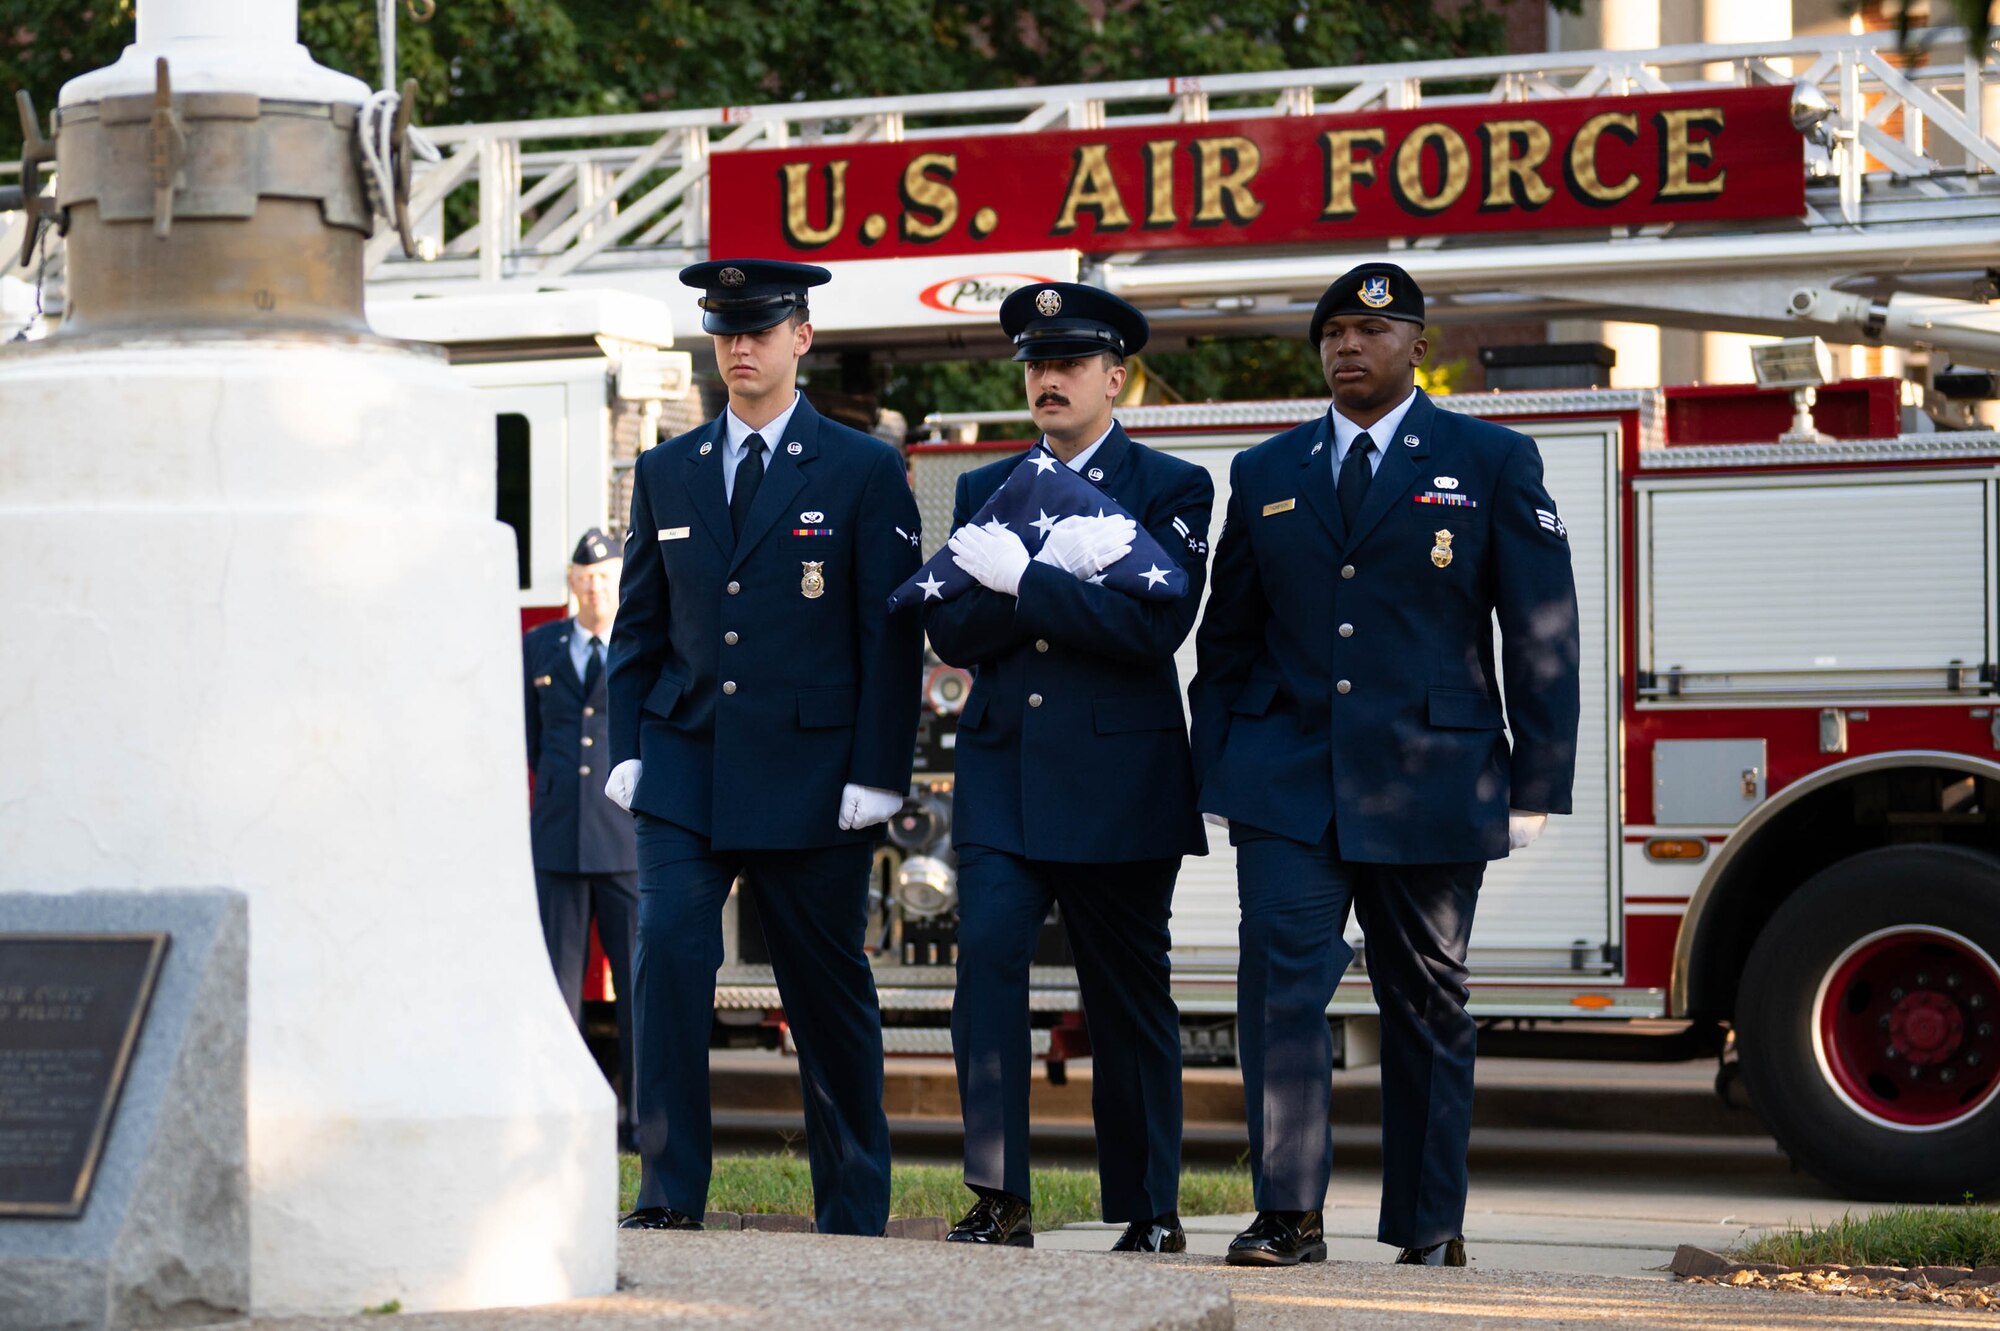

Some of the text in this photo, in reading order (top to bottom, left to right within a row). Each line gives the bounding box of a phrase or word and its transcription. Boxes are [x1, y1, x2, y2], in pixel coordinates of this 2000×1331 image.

[779, 108, 1727, 250] U.S. AIR FORCE
